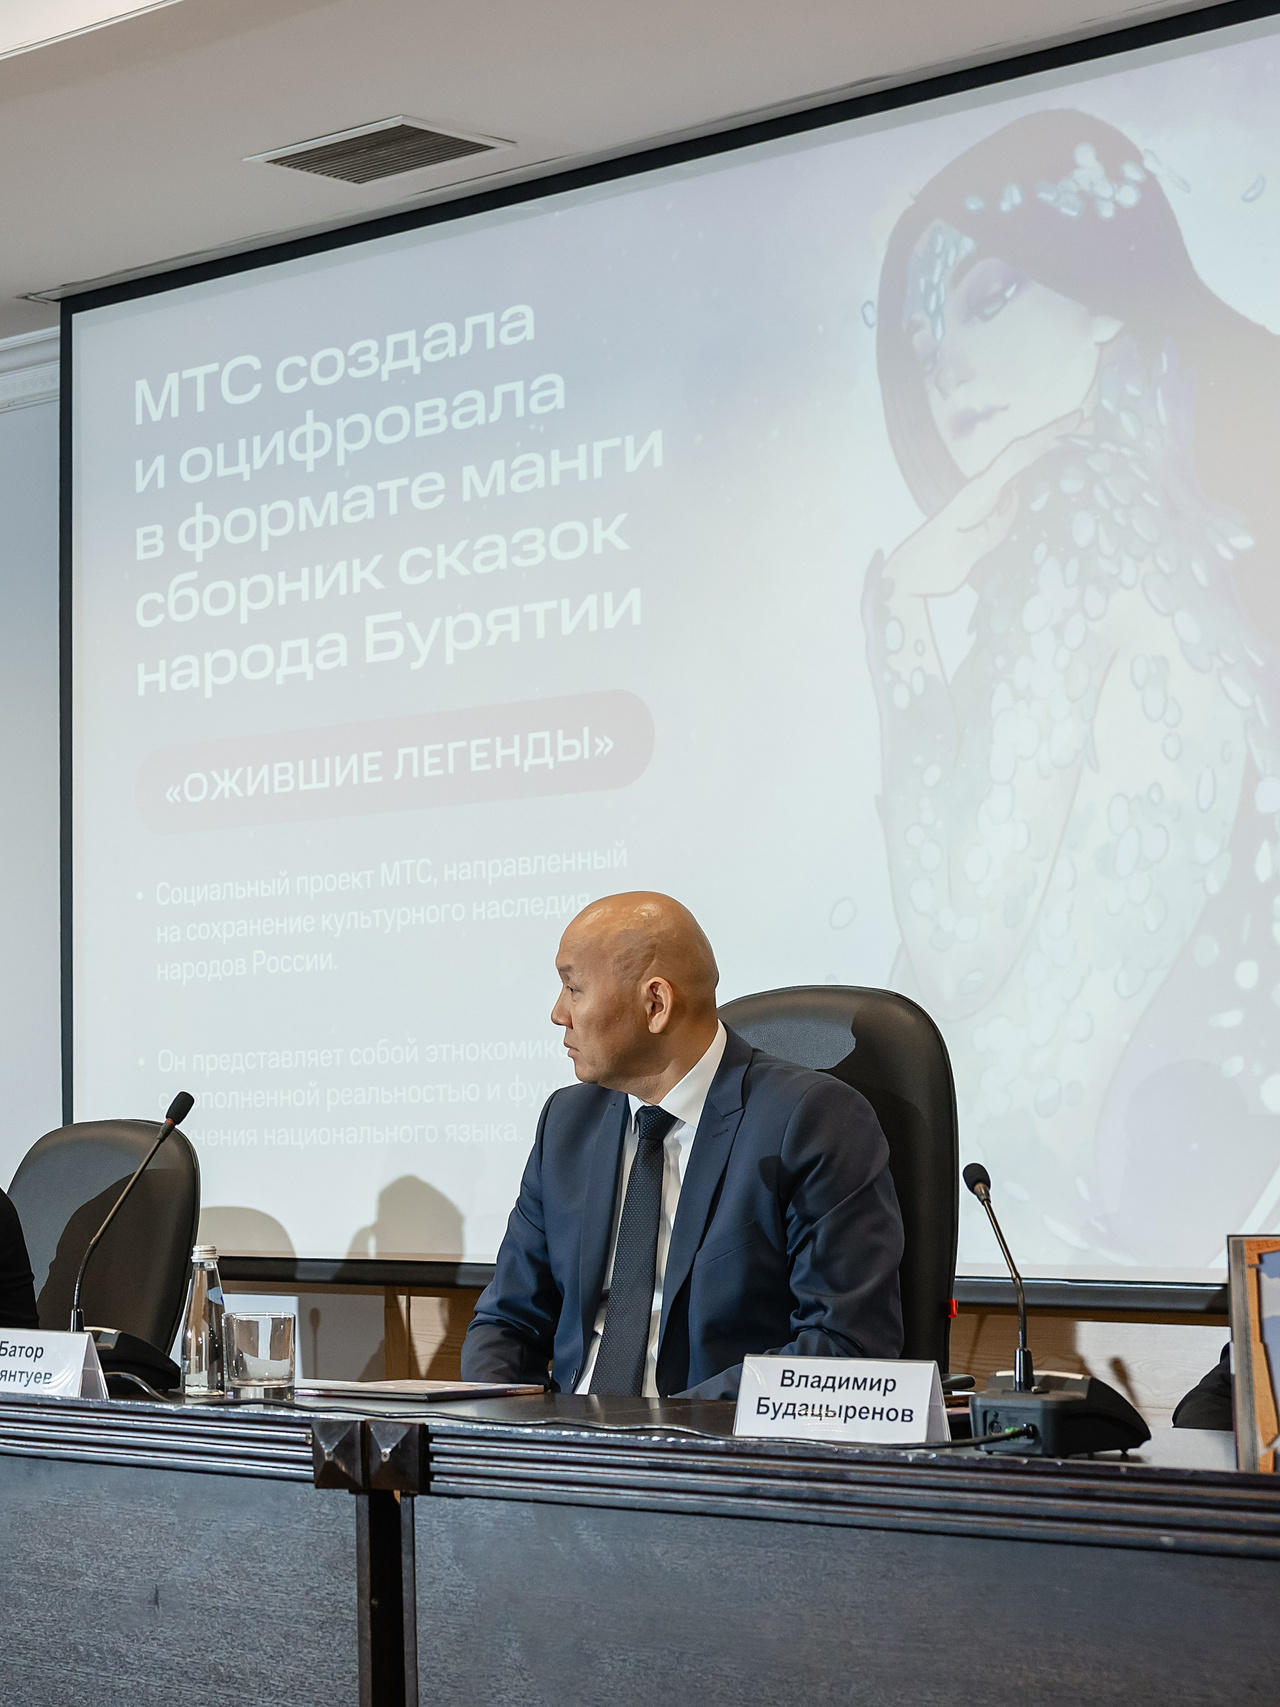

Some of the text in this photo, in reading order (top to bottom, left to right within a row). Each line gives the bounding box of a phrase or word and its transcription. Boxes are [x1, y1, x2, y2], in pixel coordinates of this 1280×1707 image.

[134, 303, 536, 426] МТС создала
[134, 372, 566, 494] и оцифровала
[135, 429, 664, 564] в формате манги
[135, 512, 630, 629] сборник сказок
[136, 586, 643, 699] народа Бурятии
[164, 725, 615, 807] «ОЖИВШИЕ ЛЕГЕНДЫ»
[155, 840, 629, 908] Социальный проект МТС, направленный
[156, 922, 181, 944] на
[186, 914, 315, 947] сохранение
[320, 900, 466, 937] культурного
[156, 949, 339, 987] народов России.
[157, 1048, 186, 1073] Он
[192, 1046, 345, 1080] представляет
[348, 1038, 420, 1068] собой
[193, 1081, 321, 1109] полненной
[325, 1078, 480, 1113] реальностью
[486, 1081, 501, 1102] и
[263, 1118, 439, 1149] национального
[444, 1119, 525, 1144] языка.
[755, 1395, 915, 1426] Будацыренов
[779, 1367, 898, 1397] Владимир
